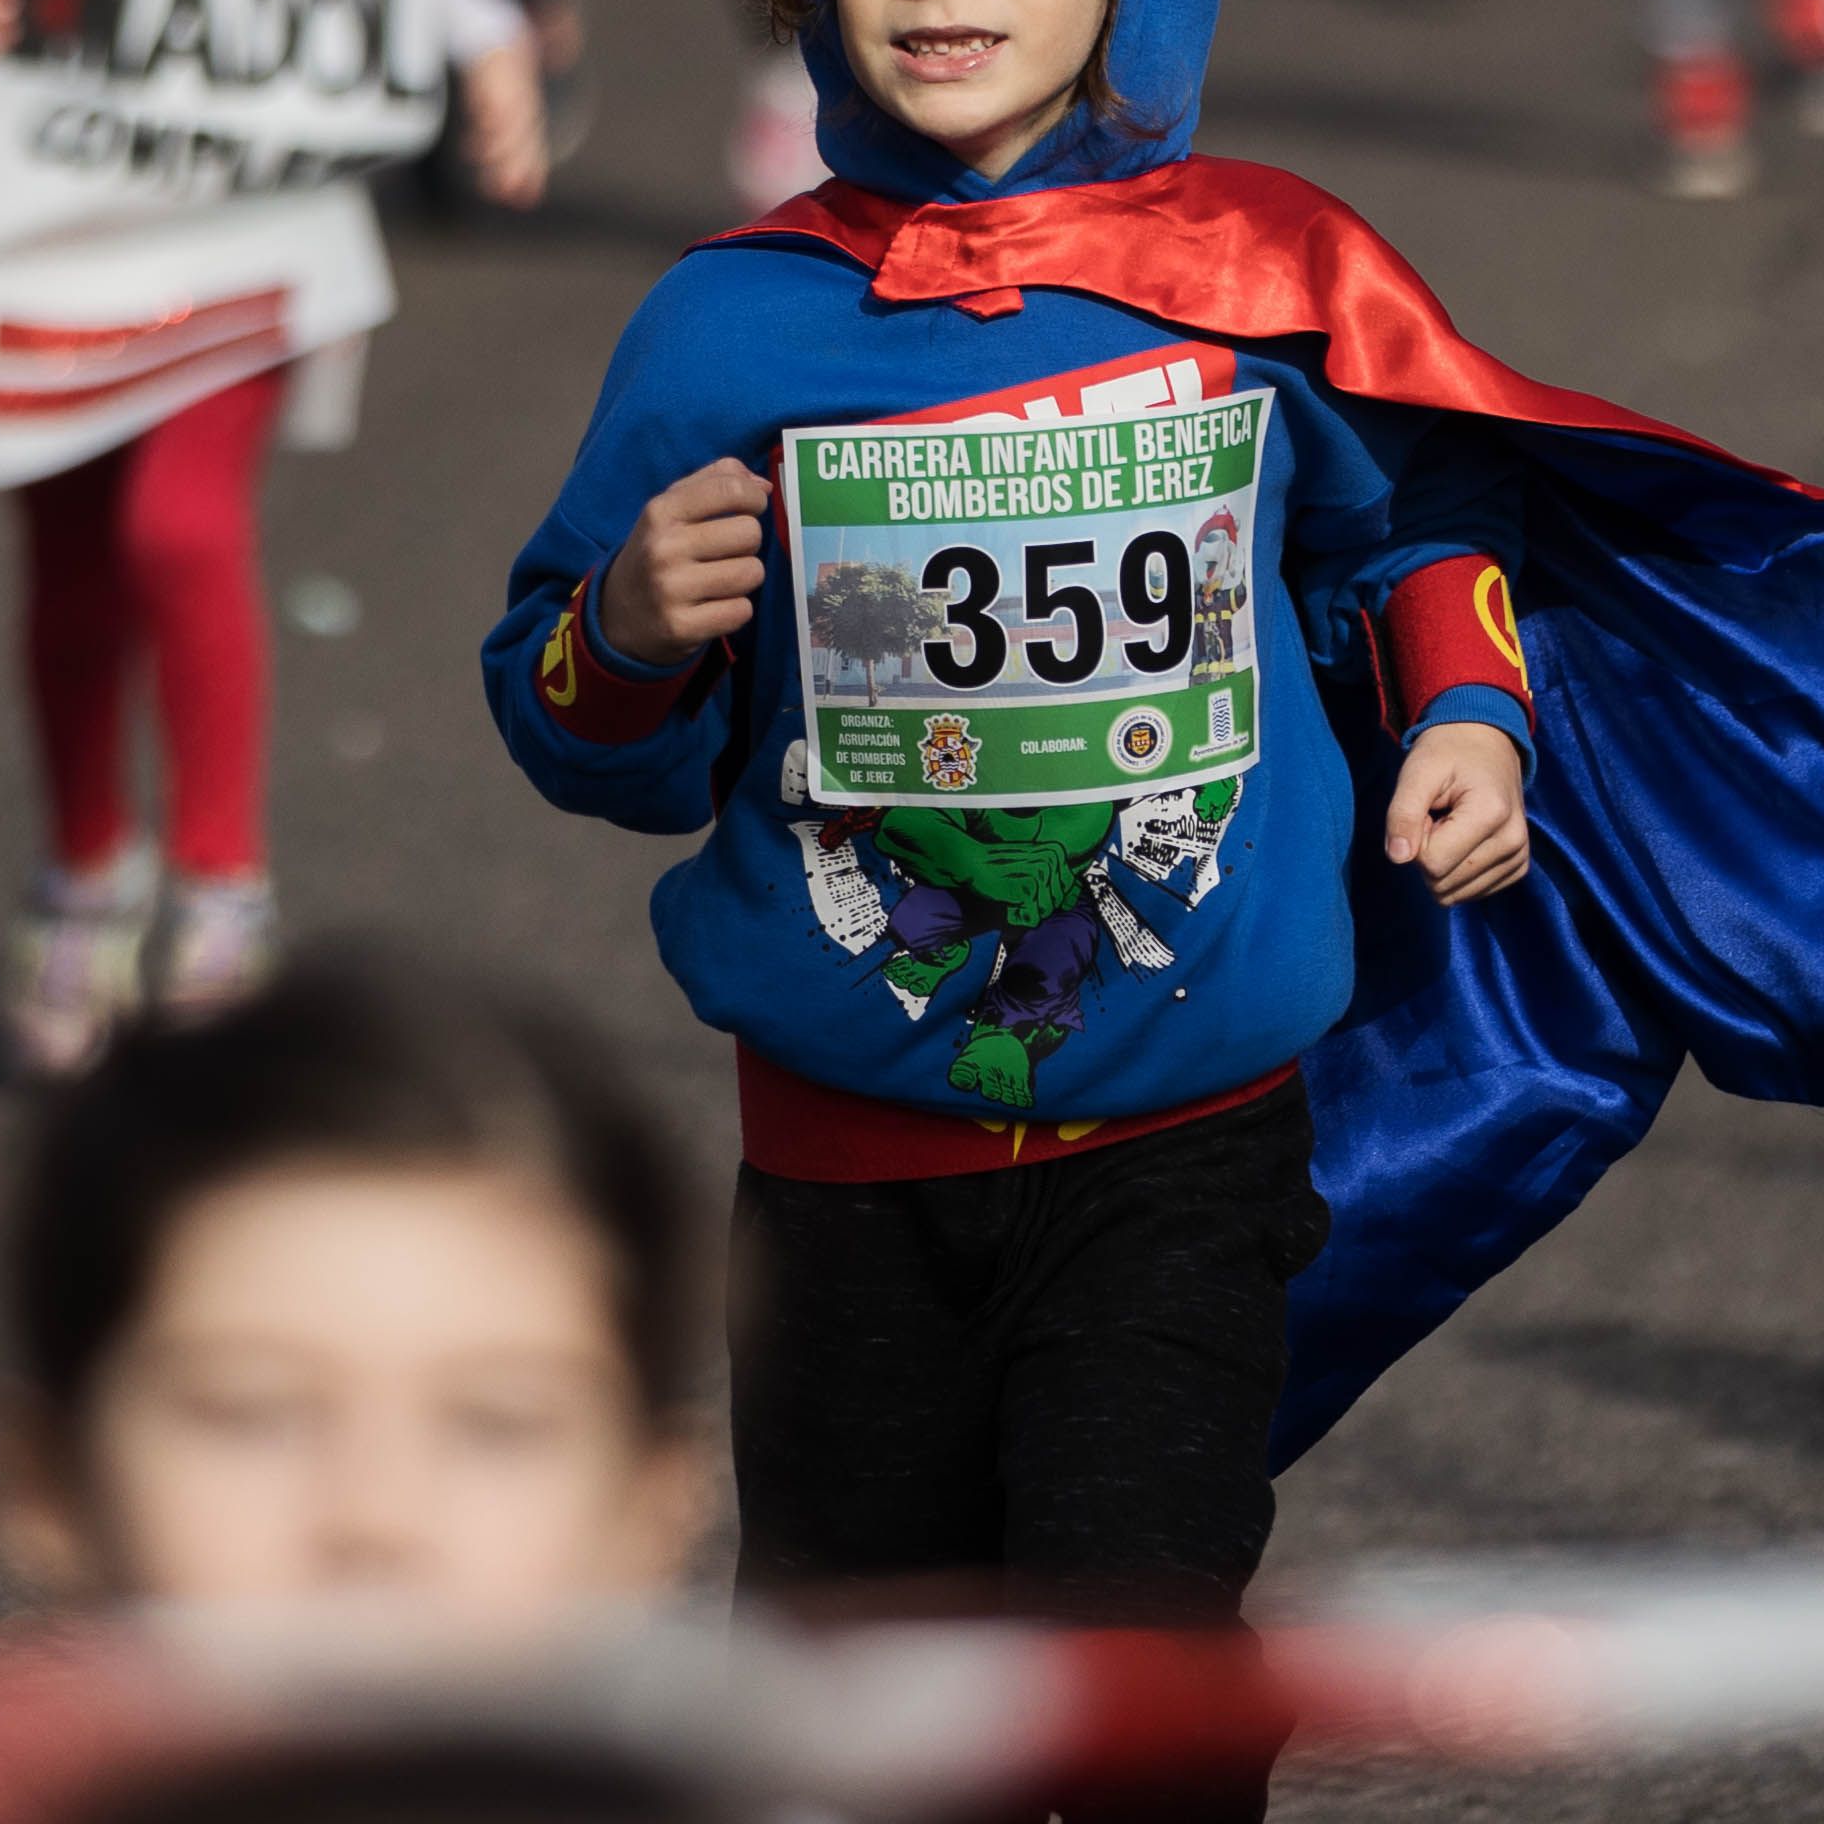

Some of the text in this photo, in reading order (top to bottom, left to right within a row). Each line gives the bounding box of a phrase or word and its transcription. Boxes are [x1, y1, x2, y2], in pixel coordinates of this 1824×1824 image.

[816, 403, 1253, 480] CARRERA INFANTIL BENÉFICA
[887, 455, 1214, 521] BOMBEROS DE JEREZ
[919, 529, 1194, 689] 359
[840, 714, 895, 729] ORGANIZA:
[838, 731, 901, 747] AGRUPACIÓN
[1020, 736, 1088, 755] COLABORAN:
[836, 751, 907, 766] DE BOMBEROS
[850, 770, 896, 784] DE JEREZ
